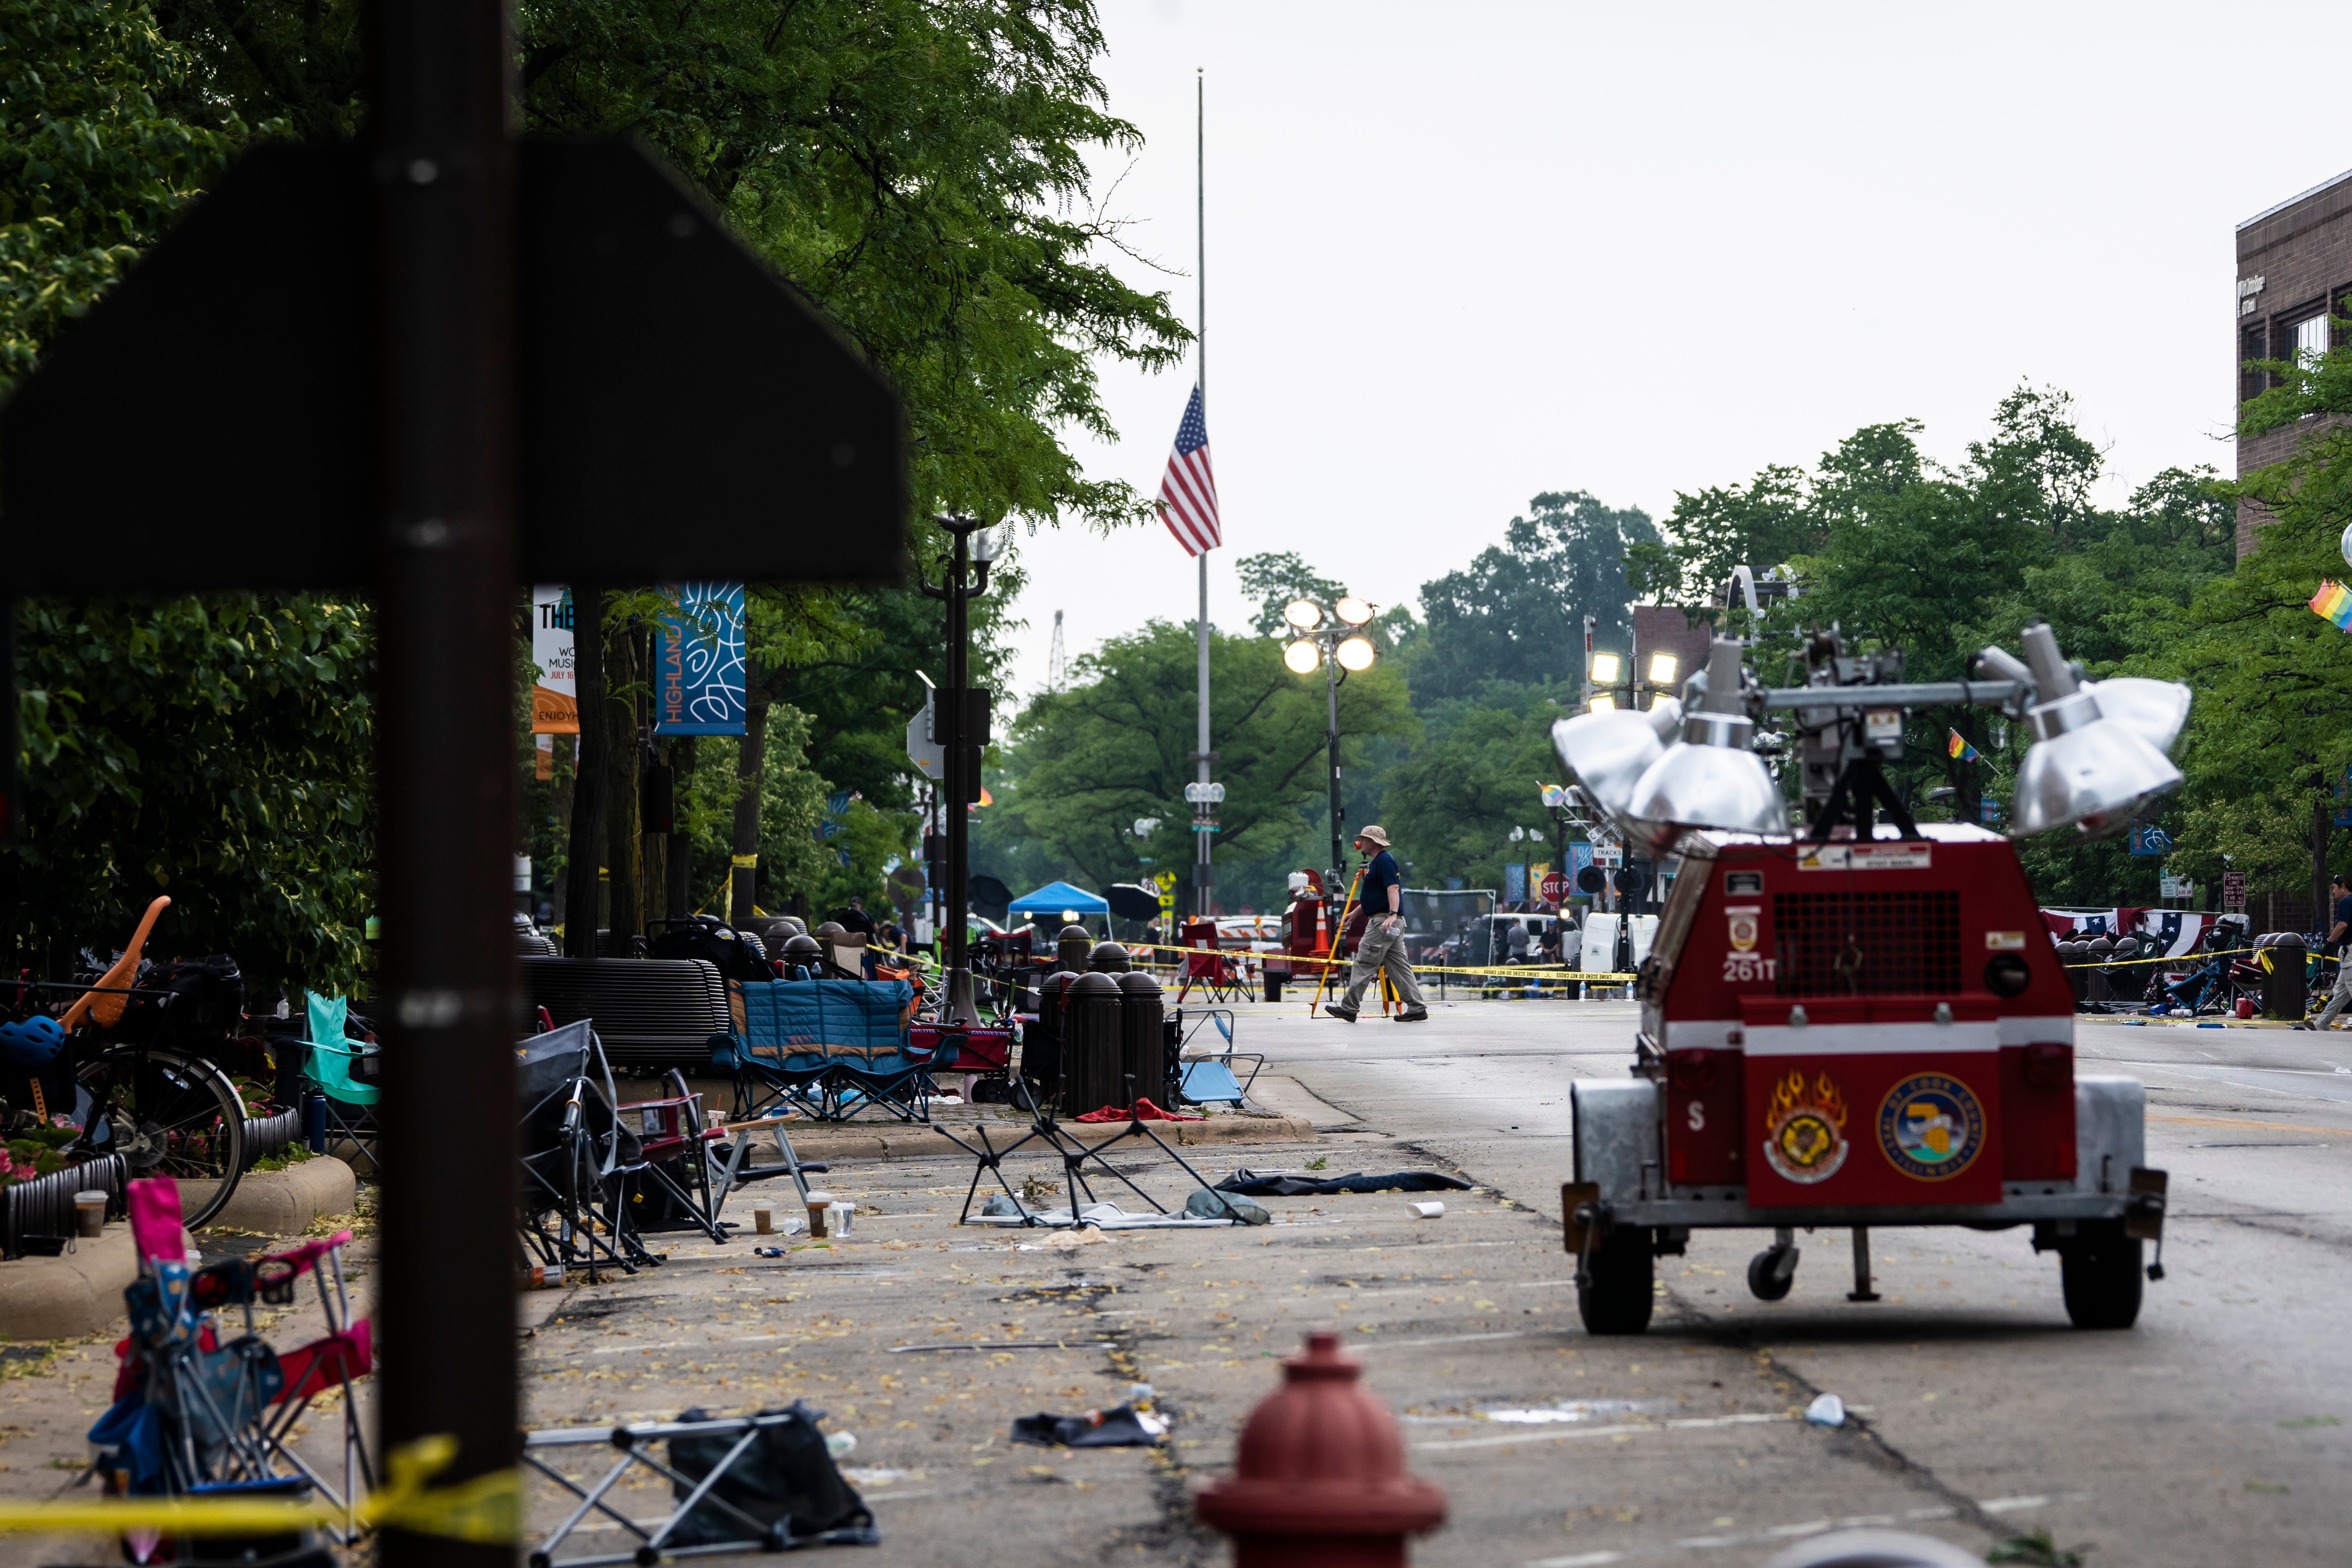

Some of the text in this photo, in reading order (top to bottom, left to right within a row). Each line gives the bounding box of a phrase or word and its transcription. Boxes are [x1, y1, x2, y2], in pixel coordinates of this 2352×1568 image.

[549, 659, 575, 668] MUSI
[550, 671, 564, 679] JULY
[665, 625, 682, 723] HIGHLAND
[1722, 959, 1777, 982] 261T
[1687, 1100, 1705, 1132] S
